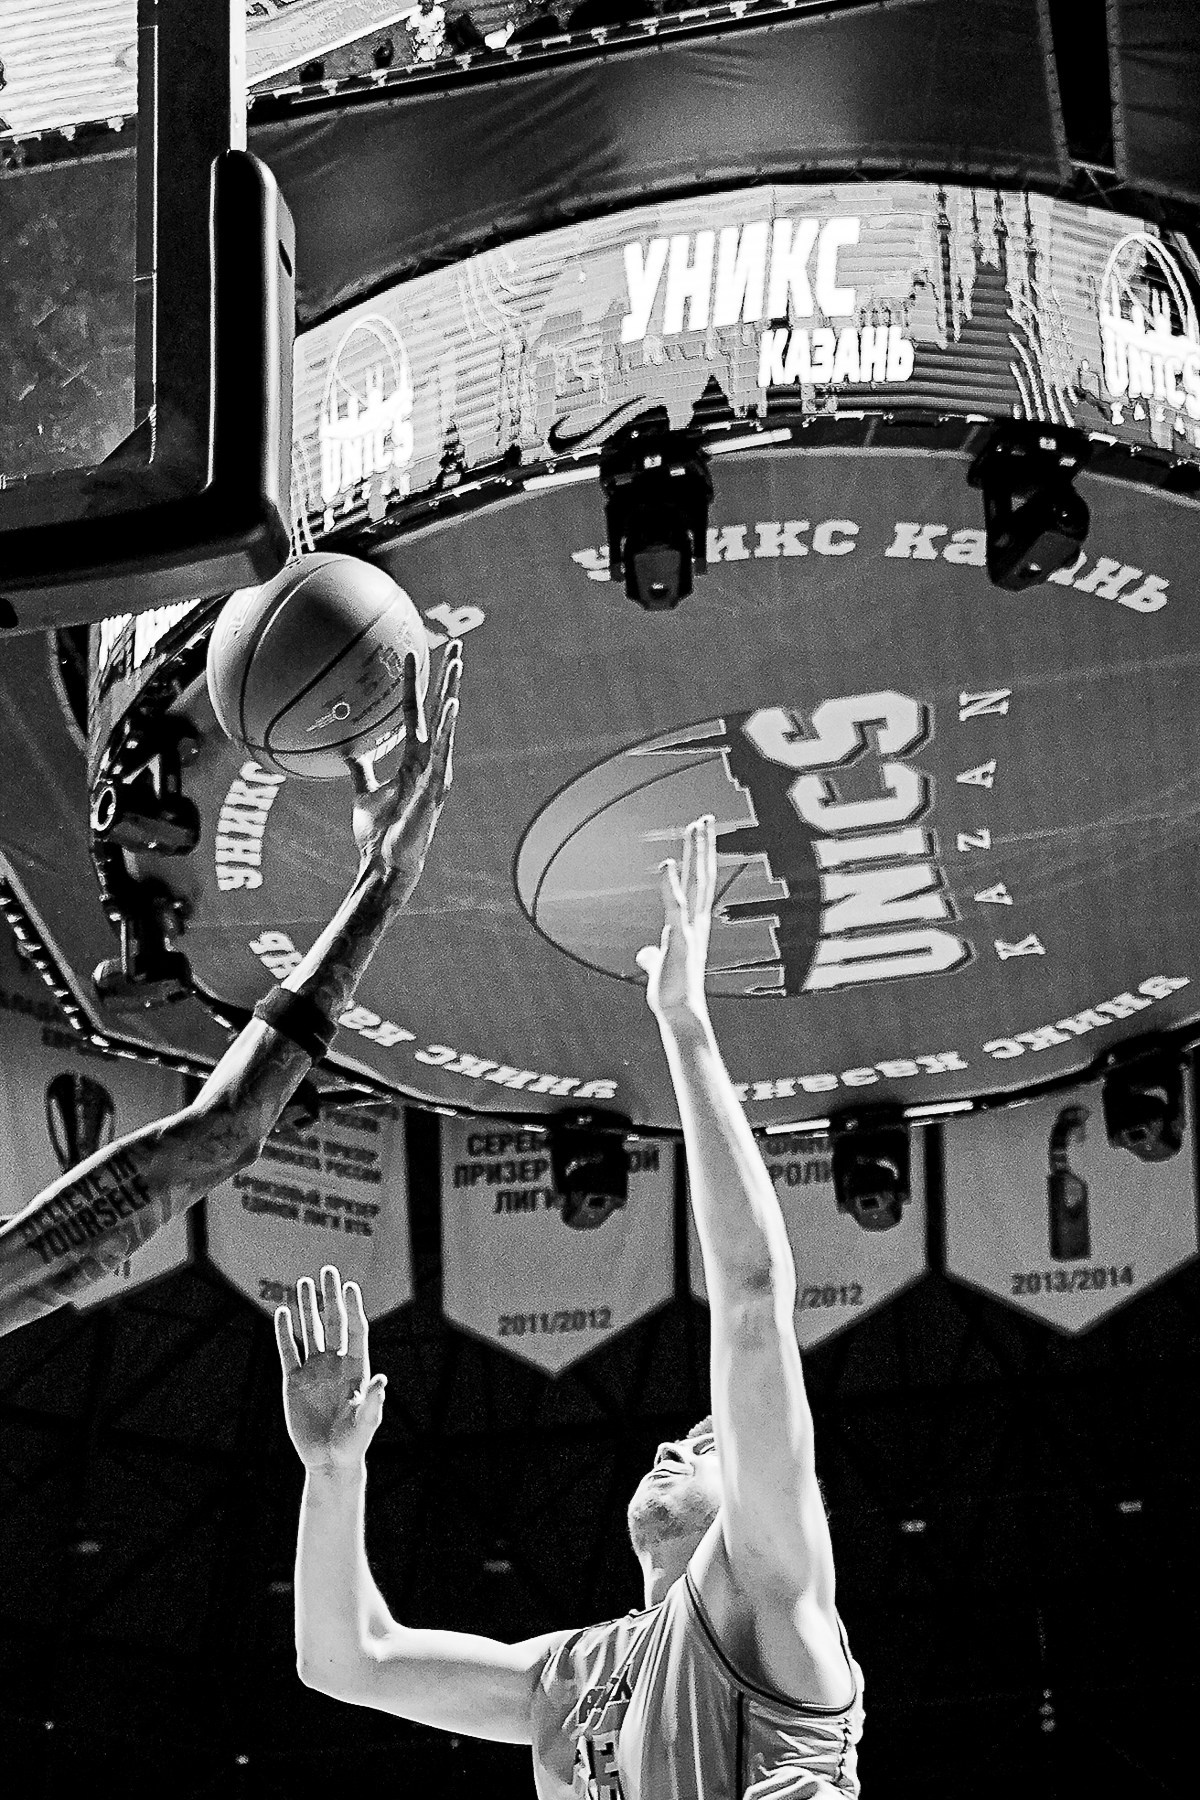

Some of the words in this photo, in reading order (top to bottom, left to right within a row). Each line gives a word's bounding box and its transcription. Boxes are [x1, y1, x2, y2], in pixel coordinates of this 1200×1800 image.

[620, 217, 861, 345] УНИКС
[757, 325, 915, 388] КАЗАНЬ
[743, 689, 975, 991] UNICS
